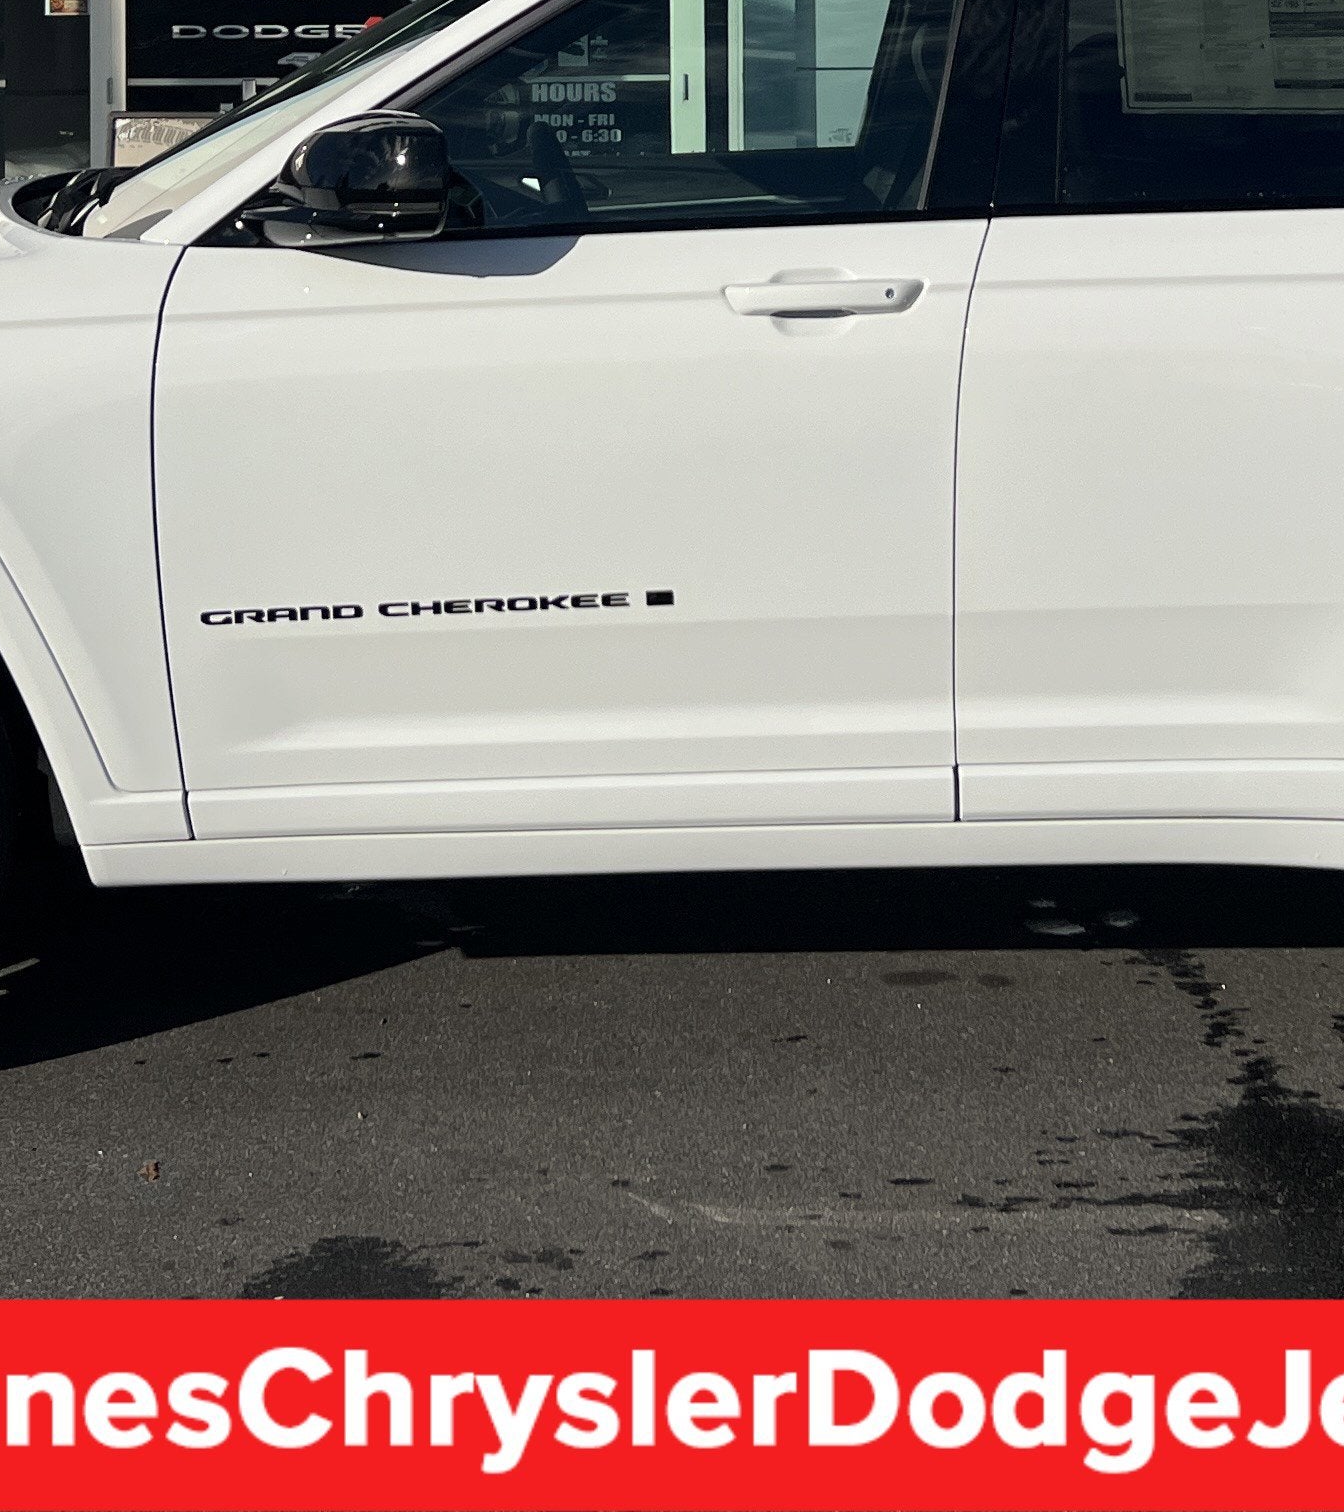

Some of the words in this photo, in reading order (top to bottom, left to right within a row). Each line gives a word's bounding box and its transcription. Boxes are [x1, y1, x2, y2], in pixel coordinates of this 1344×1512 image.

[171, 24, 367, 39] DODGE
[531, 81, 617, 103] HOURS
[534, 113, 573, 127] MON
[588, 113, 615, 126] FRI
[581, 129, 622, 142] 6:30
[199, 603, 364, 626] GRAND
[377, 591, 630, 618] CHEROKEE
